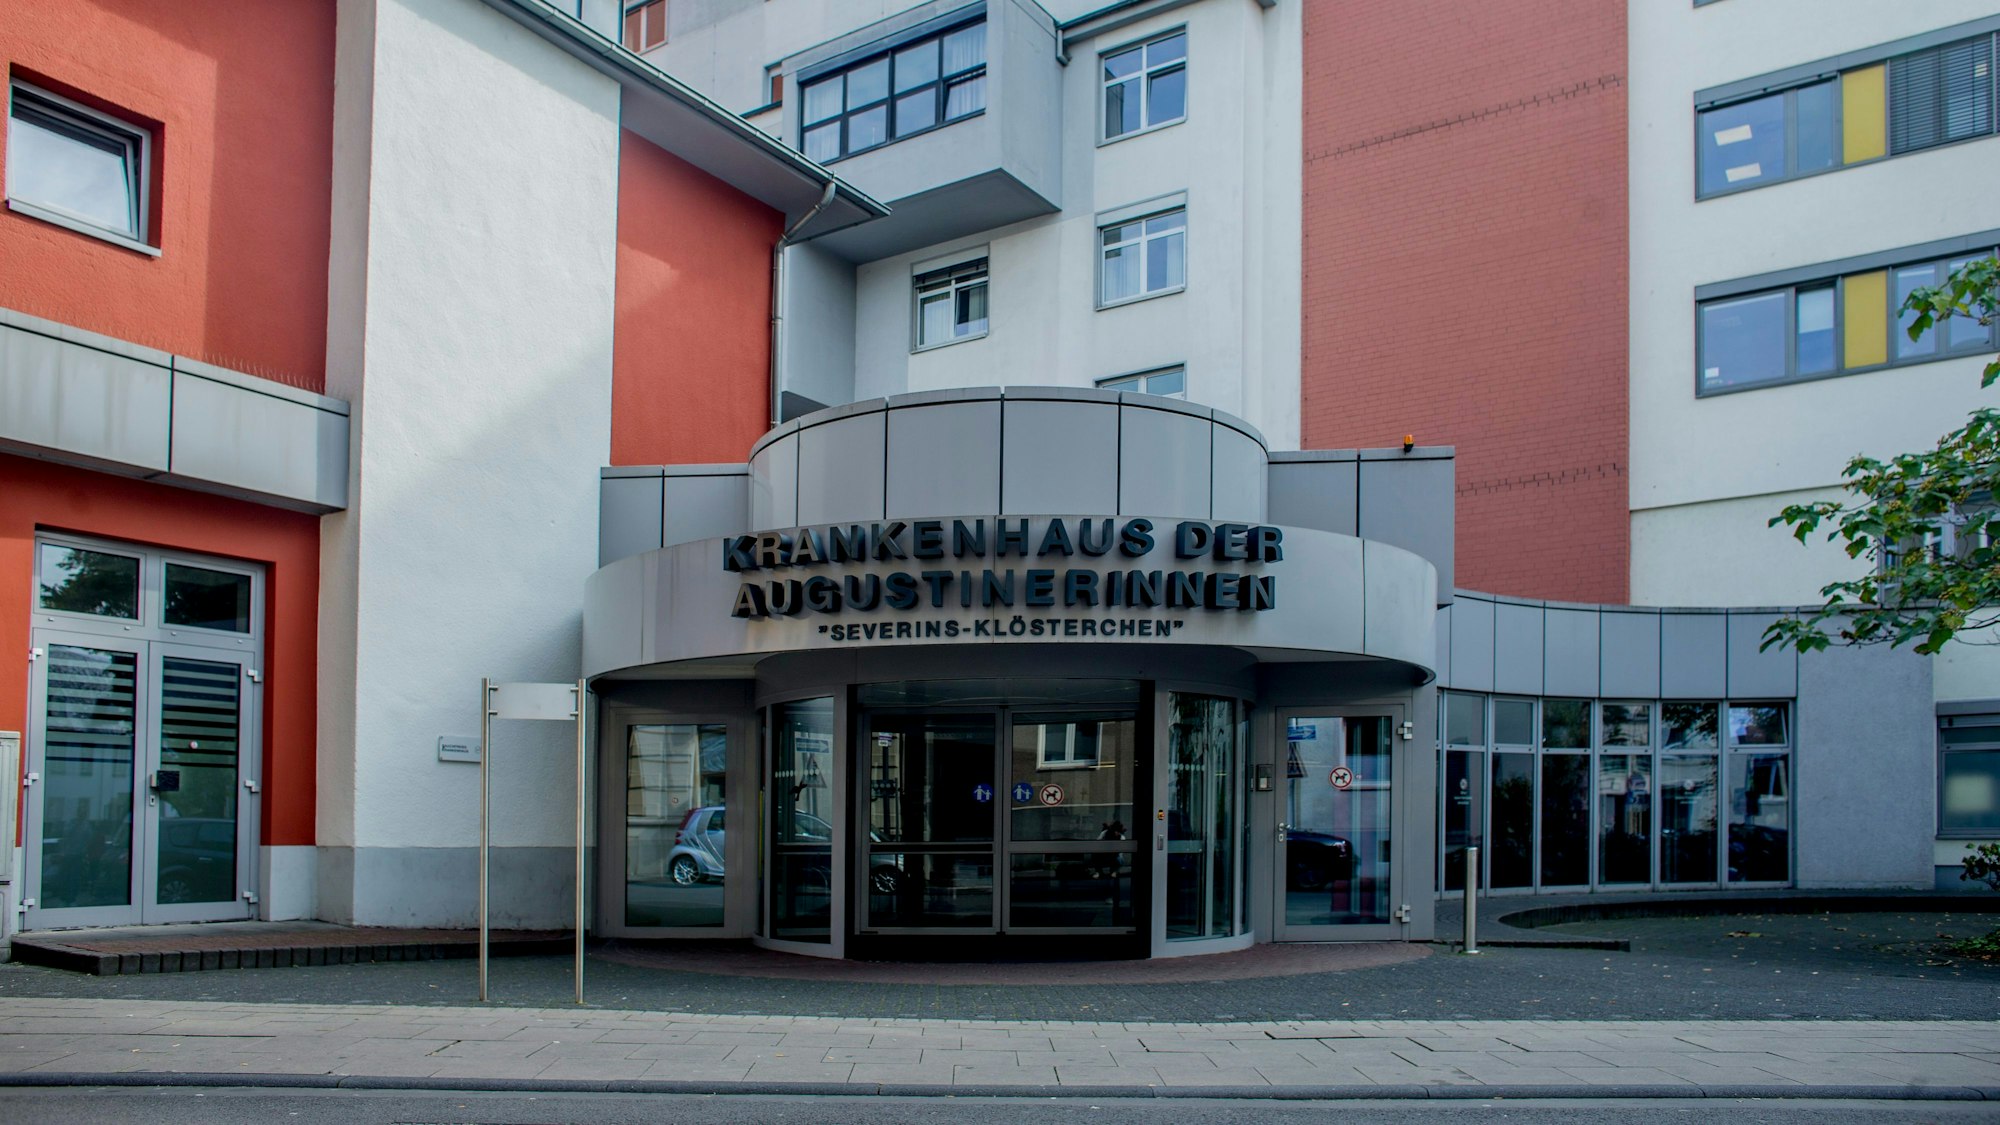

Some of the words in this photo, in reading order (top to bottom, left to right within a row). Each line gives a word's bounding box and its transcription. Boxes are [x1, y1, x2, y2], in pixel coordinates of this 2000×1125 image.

[723, 518, 1155, 572] KRANKENHAUS
[1175, 520, 1283, 563] DER
[731, 568, 1276, 617] AUGUSTINERINNEN
